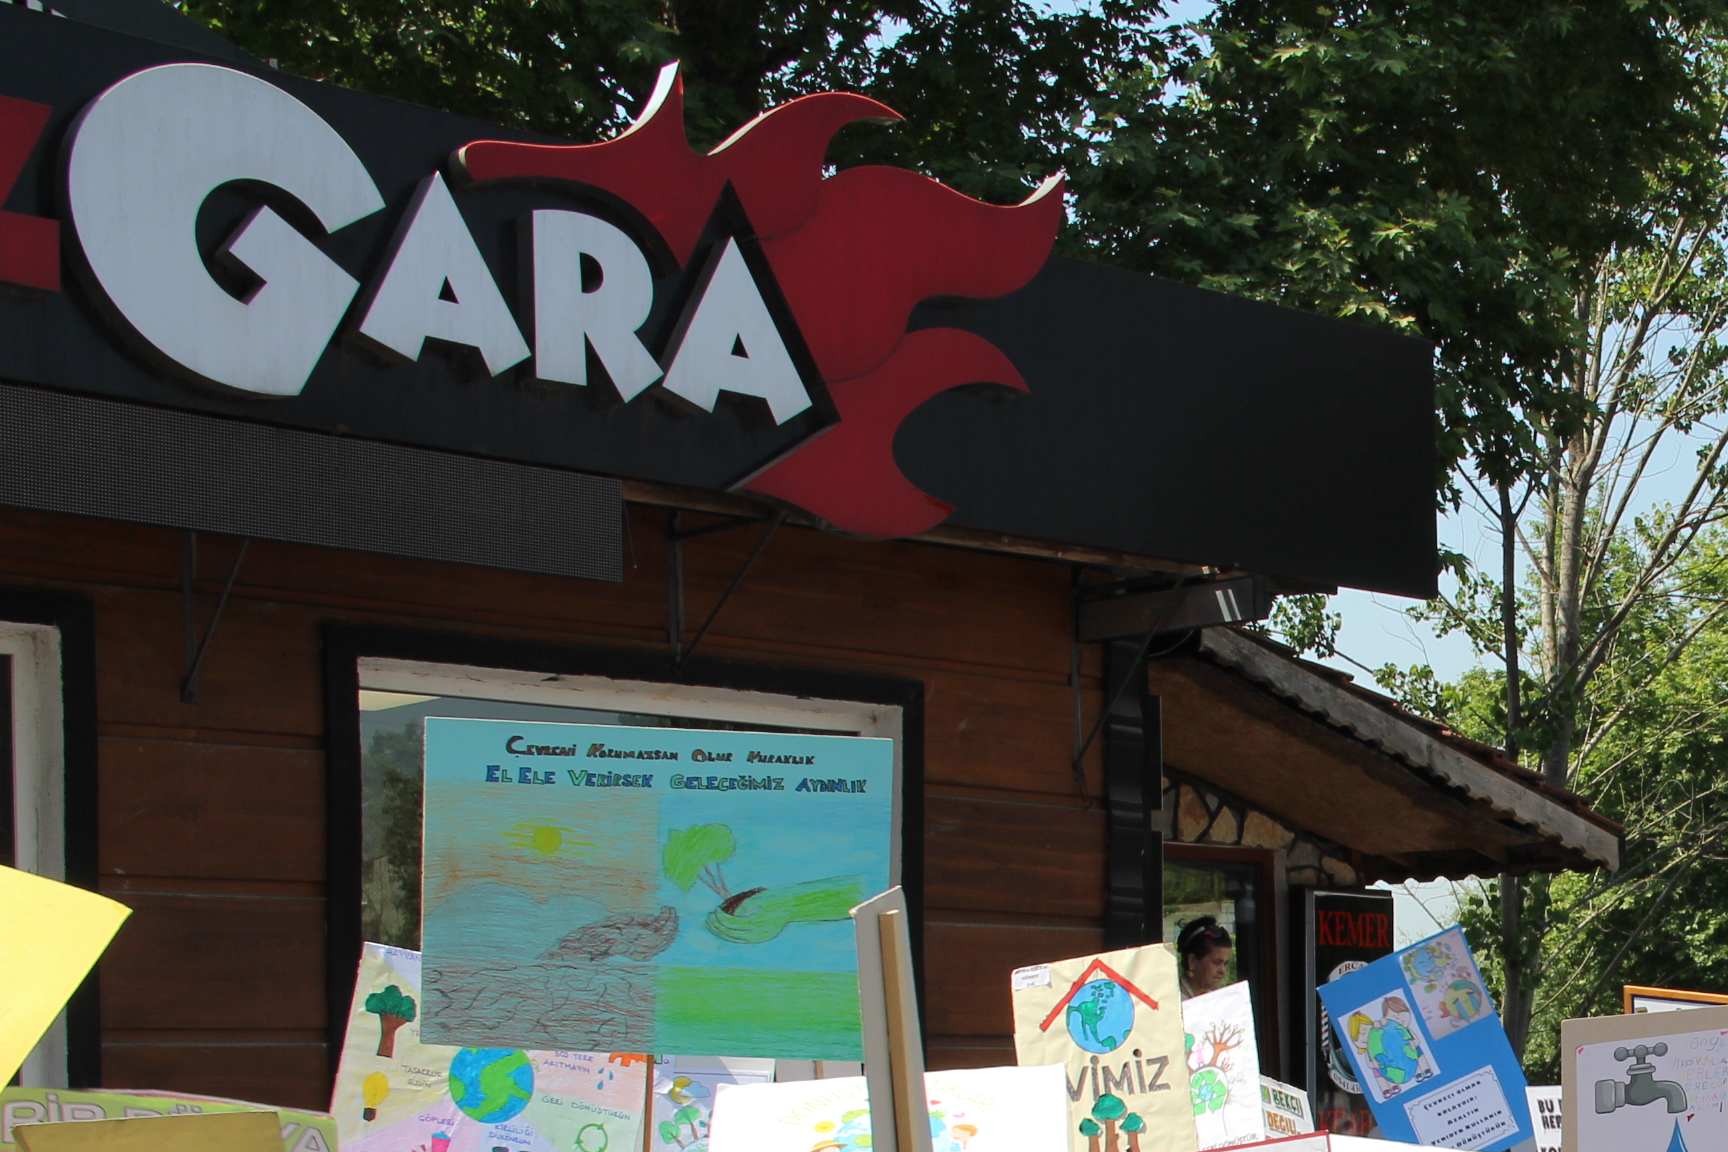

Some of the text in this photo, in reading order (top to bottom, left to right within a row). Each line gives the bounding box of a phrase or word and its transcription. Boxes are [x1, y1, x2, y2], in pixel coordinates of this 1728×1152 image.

[486, 765, 867, 793] EL ELE VERİRSEK GELECEĞİMİZ AYDINLIK
[1317, 909, 1391, 948] KEMER
[1537, 1099, 1555, 1114] BU
